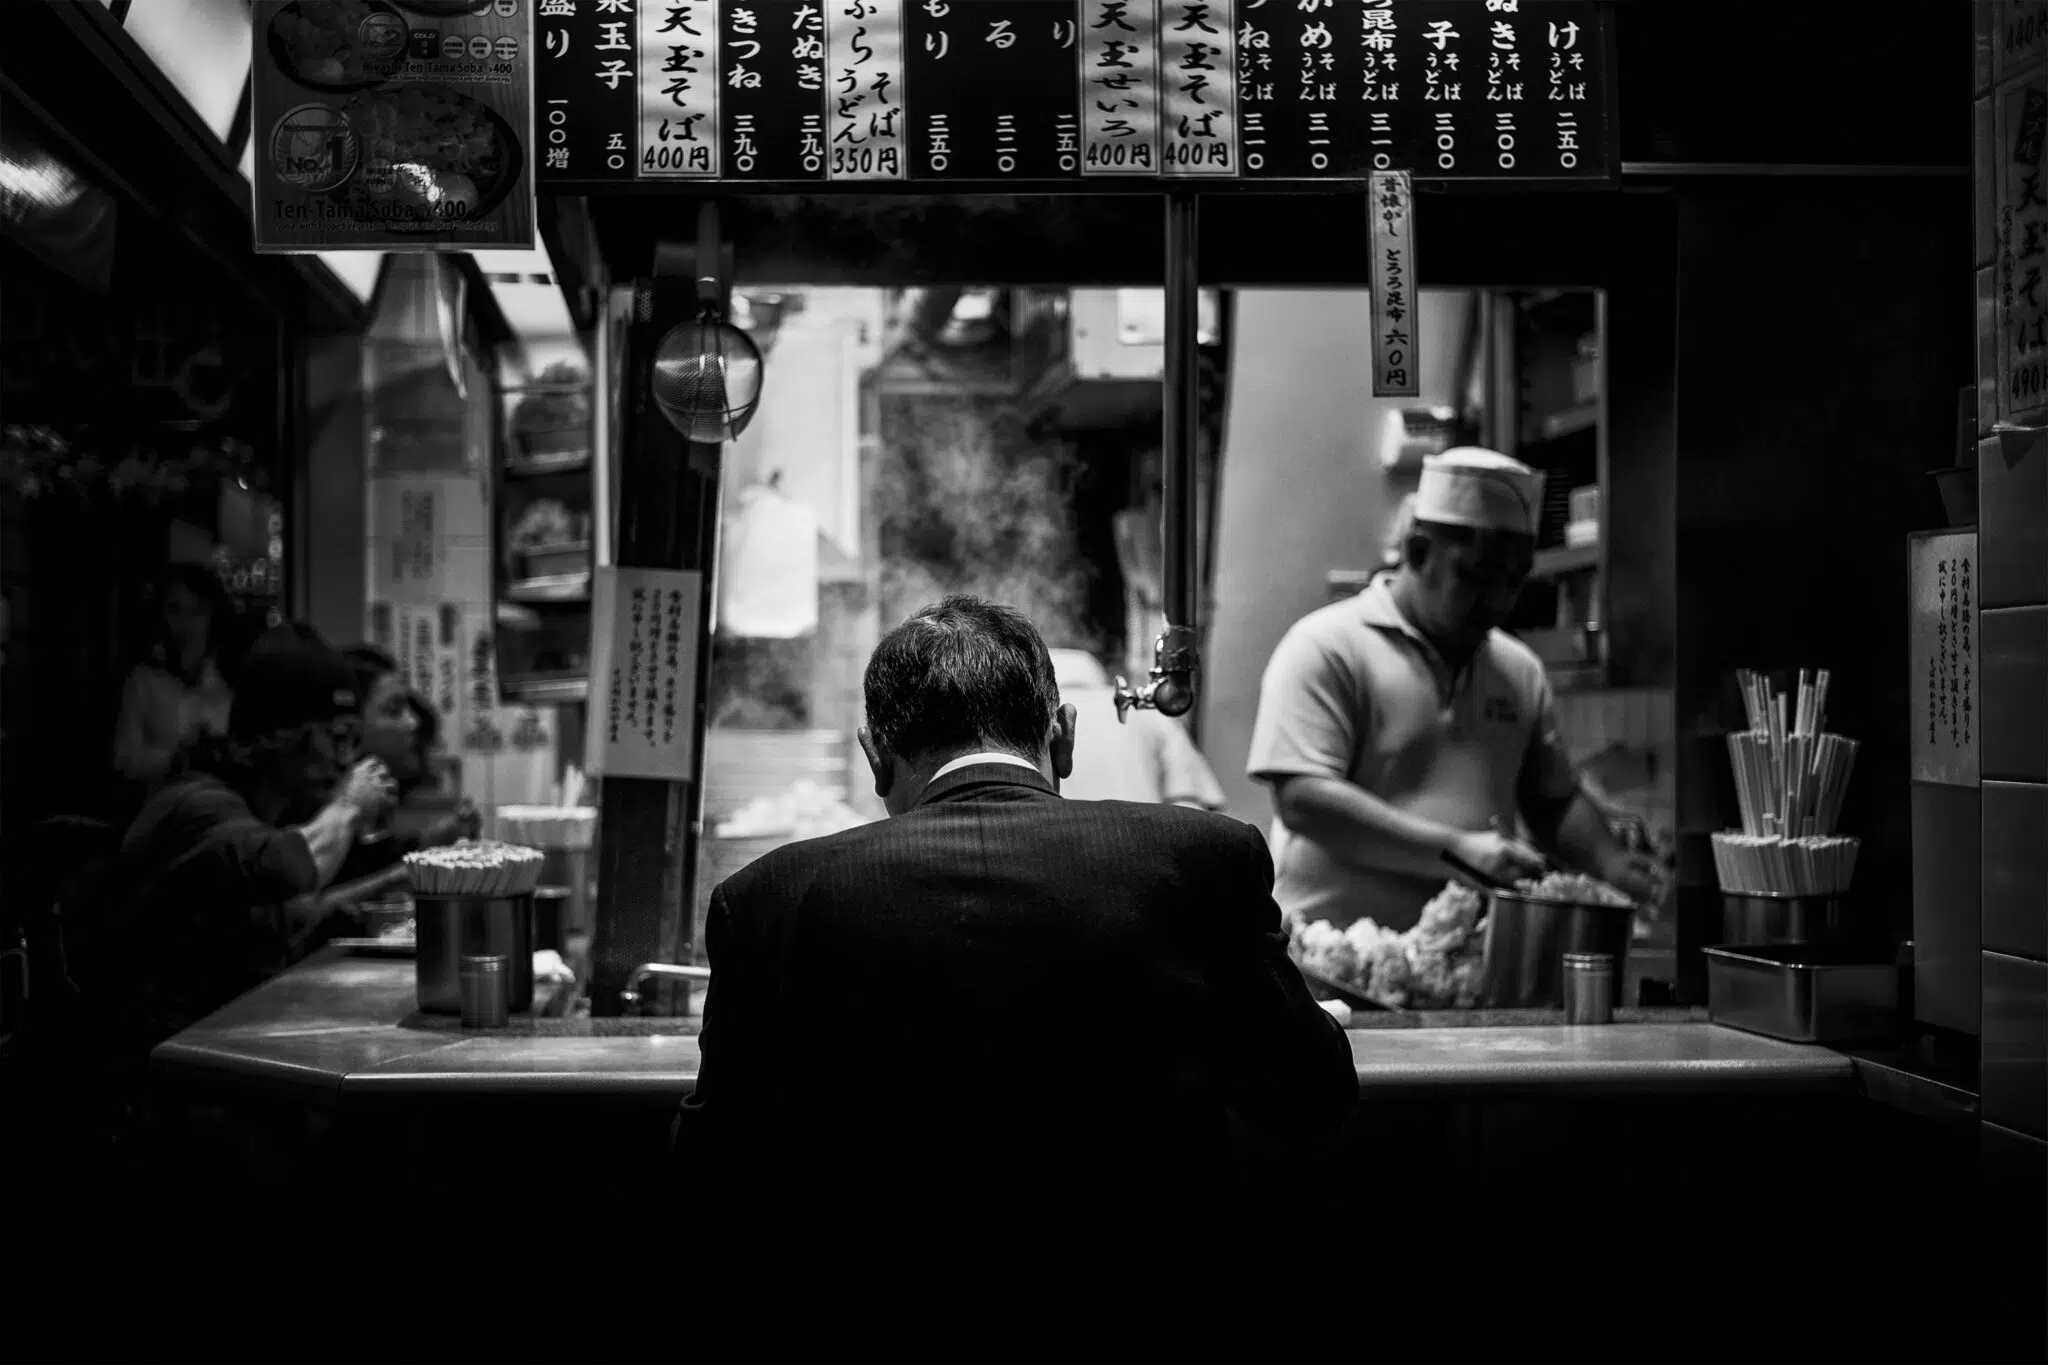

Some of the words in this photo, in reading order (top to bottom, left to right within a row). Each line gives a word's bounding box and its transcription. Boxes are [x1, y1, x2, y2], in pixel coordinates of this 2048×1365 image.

[458, 62, 483, 73] Soba
[727, 7, 762, 89] きつね
[791, 3, 824, 90] たぬき
[1173, 4, 1224, 139] 天玉そば
[1256, 53, 1274, 100] そば
[1299, 52, 1317, 101] うどん
[1319, 52, 1337, 100] そば
[1361, 52, 1379, 101] うどん
[1381, 52, 1400, 101] そば
[1424, 52, 1442, 101] うどん
[1443, 52, 1462, 101] そば
[1486, 52, 1504, 101] うどん
[1505, 52, 1524, 101] そば
[1548, 52, 1566, 101] うどん
[1568, 52, 1586, 100] そば
[832, 68, 867, 145] うどん
[869, 72, 900, 139] そば
[643, 145, 710, 172] 400円
[831, 147, 899, 176] 350円
[1086, 142, 1151, 168] 400円
[1164, 141, 1229, 168] 400円
